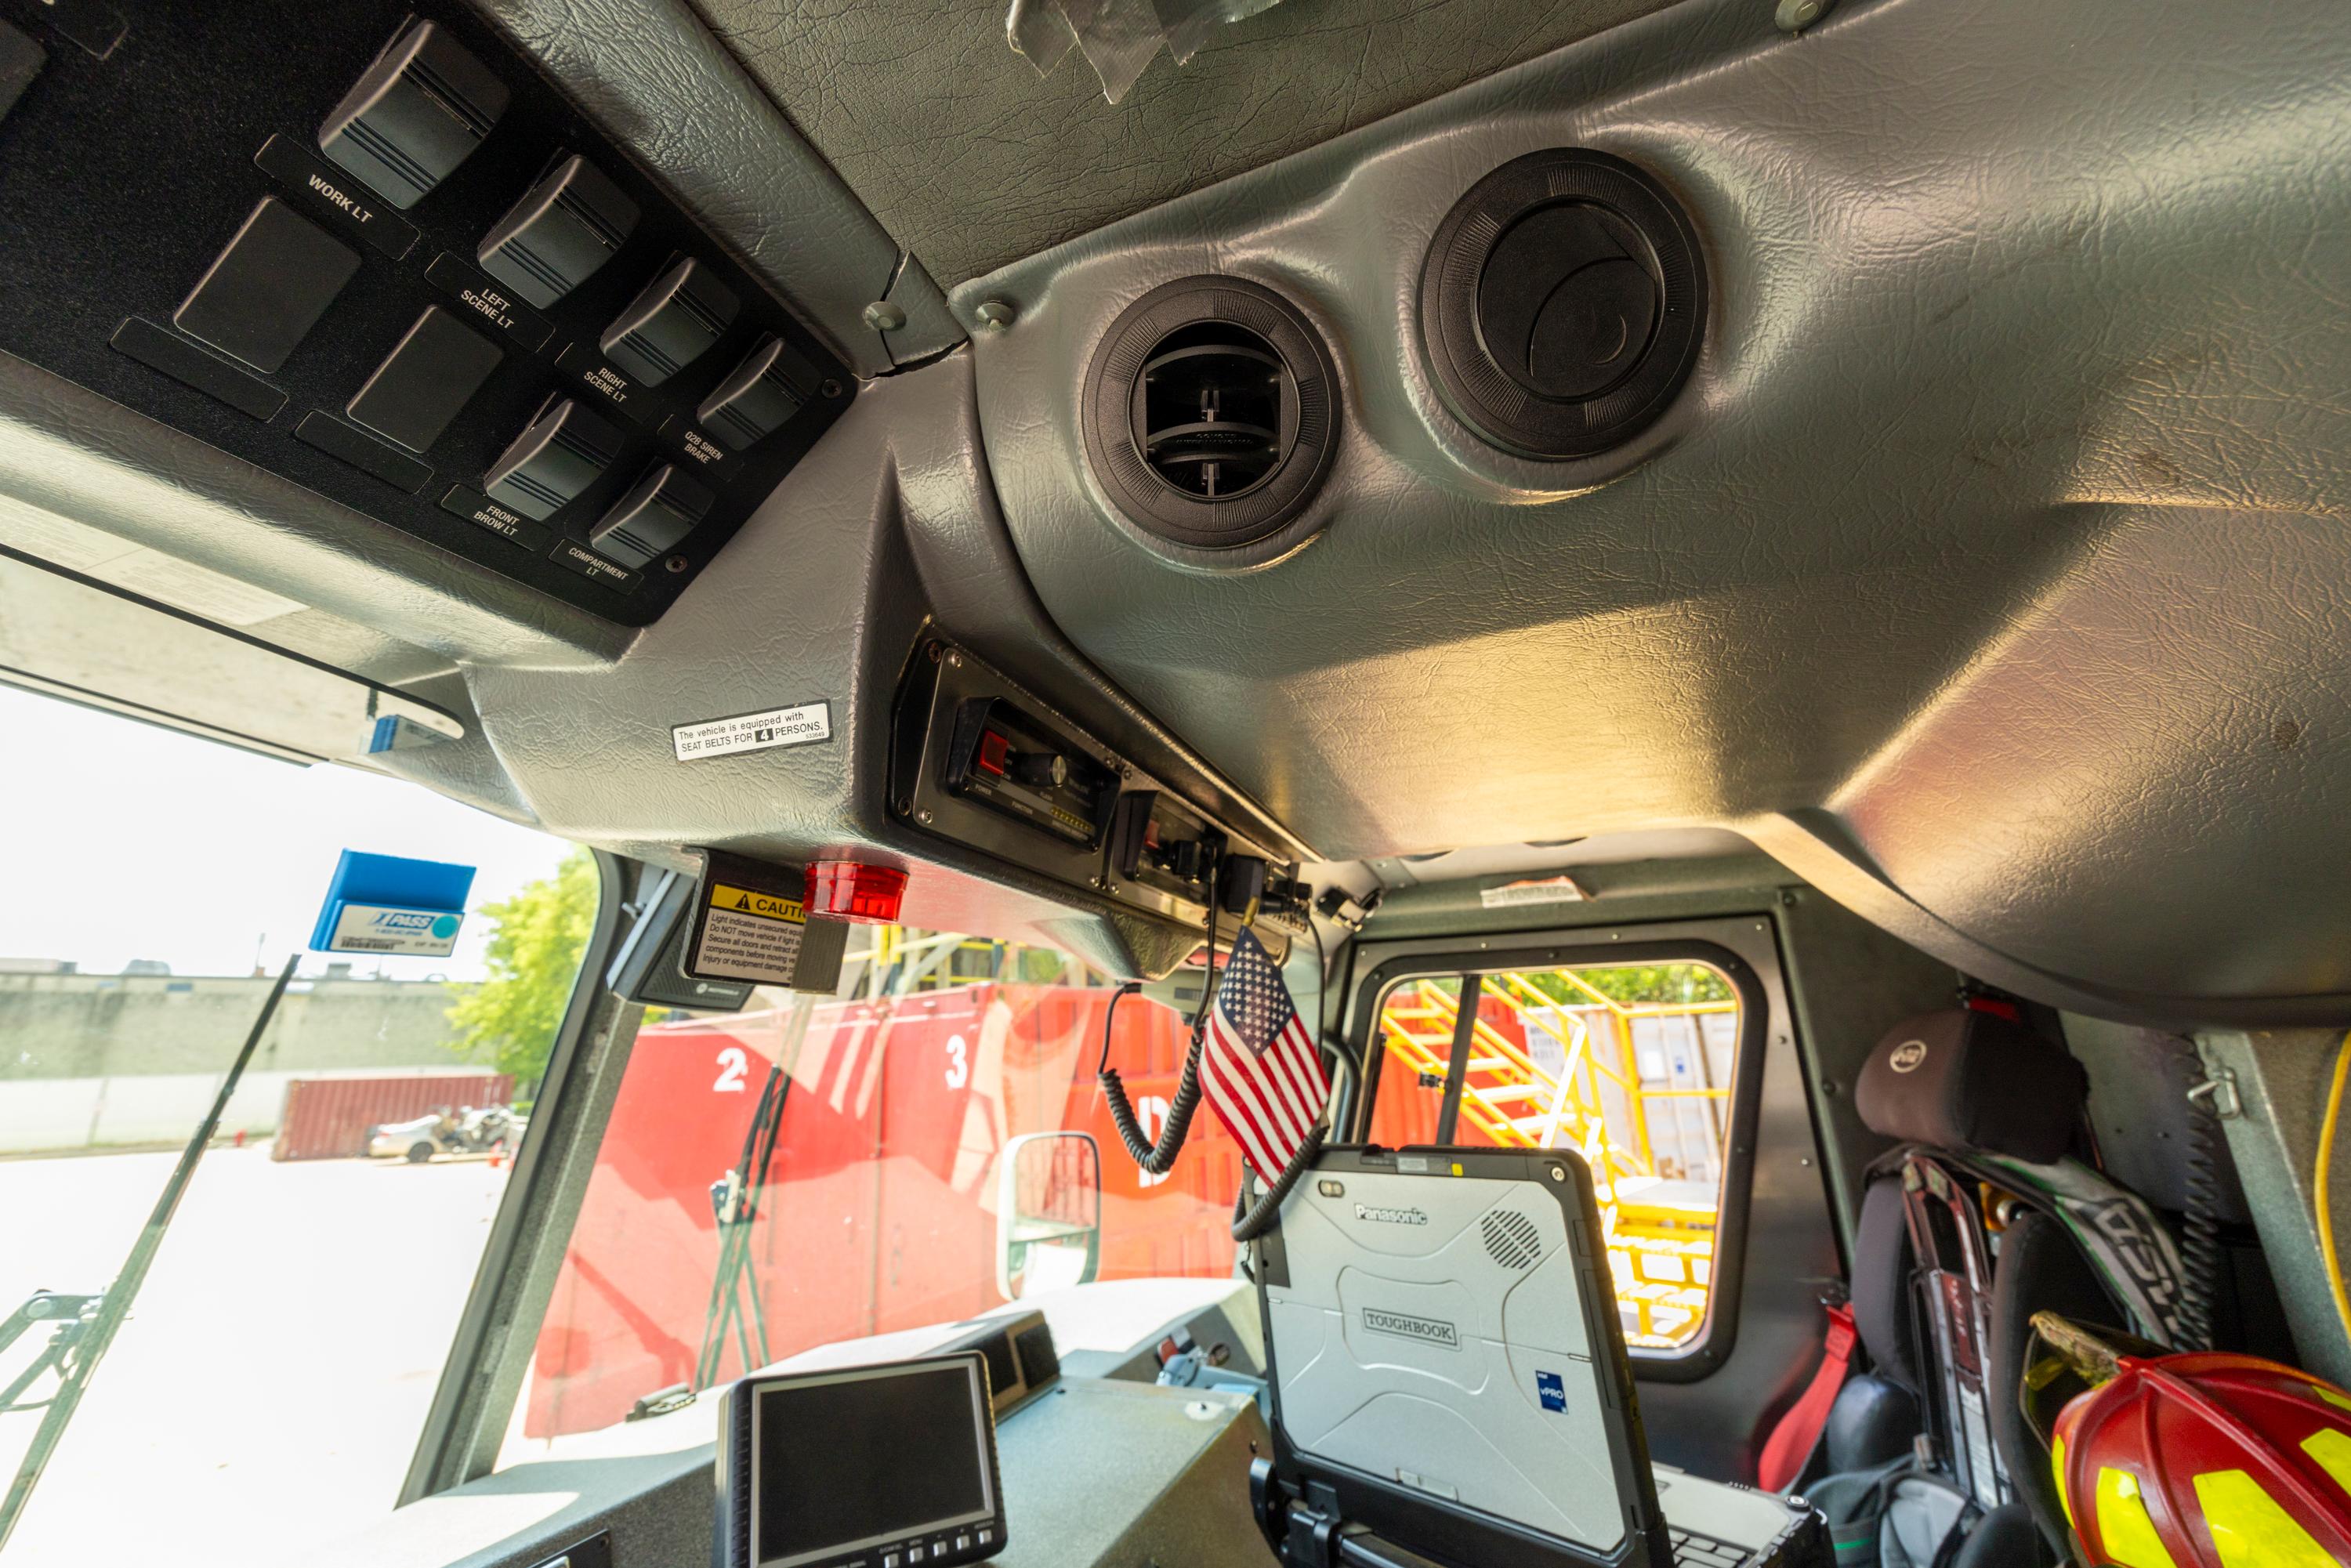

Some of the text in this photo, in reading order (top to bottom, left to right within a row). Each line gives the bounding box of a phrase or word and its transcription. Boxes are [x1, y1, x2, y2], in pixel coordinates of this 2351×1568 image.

[308, 174, 373, 223] WORK LT
[461, 290, 514, 329] SCENE LT
[481, 288, 511, 312] LEFT
[584, 371, 627, 403] SCENE LT
[598, 367, 628, 389] RIGHT
[684, 443, 711, 464] BRAKE
[700, 441, 723, 461] SIREN
[473, 511, 518, 536] BROW LT
[486, 505, 520, 525] FRONT
[568, 547, 629, 580] COMPARTMENT
[586, 567, 600, 576] LT
[679, 712, 804, 741] The vehicle is equipped with
[682, 741, 702, 752] SEAT
[705, 736, 731, 749] BELTS
[734, 733, 753, 744] FOR
[775, 721, 823, 737] PERSONS.
[756, 899, 806, 918] CAUTI
[710, 924, 719, 932] Do
[756, 932, 777, 941] vehicle
[783, 936, 795, 945] light
[712, 914, 727, 924] Light
[729, 918, 756, 929] indicates
[758, 923, 788, 934] unsecured
[706, 945, 744, 957] components
[746, 950, 766, 959] before
[766, 954, 787, 964] moving
[708, 934, 731, 945] Secure
[741, 940, 759, 949] doors
[773, 945, 792, 954] retract
[703, 954, 722, 965] Injury
[730, 958, 763, 969] equipment
[764, 962, 788, 972] damage
[713, 1048, 748, 1092] 2
[945, 1034, 967, 1089] 3
[1354, 1203, 1428, 1226] Panasonic
[1367, 1313, 1453, 1340] TOUGHBOOK
